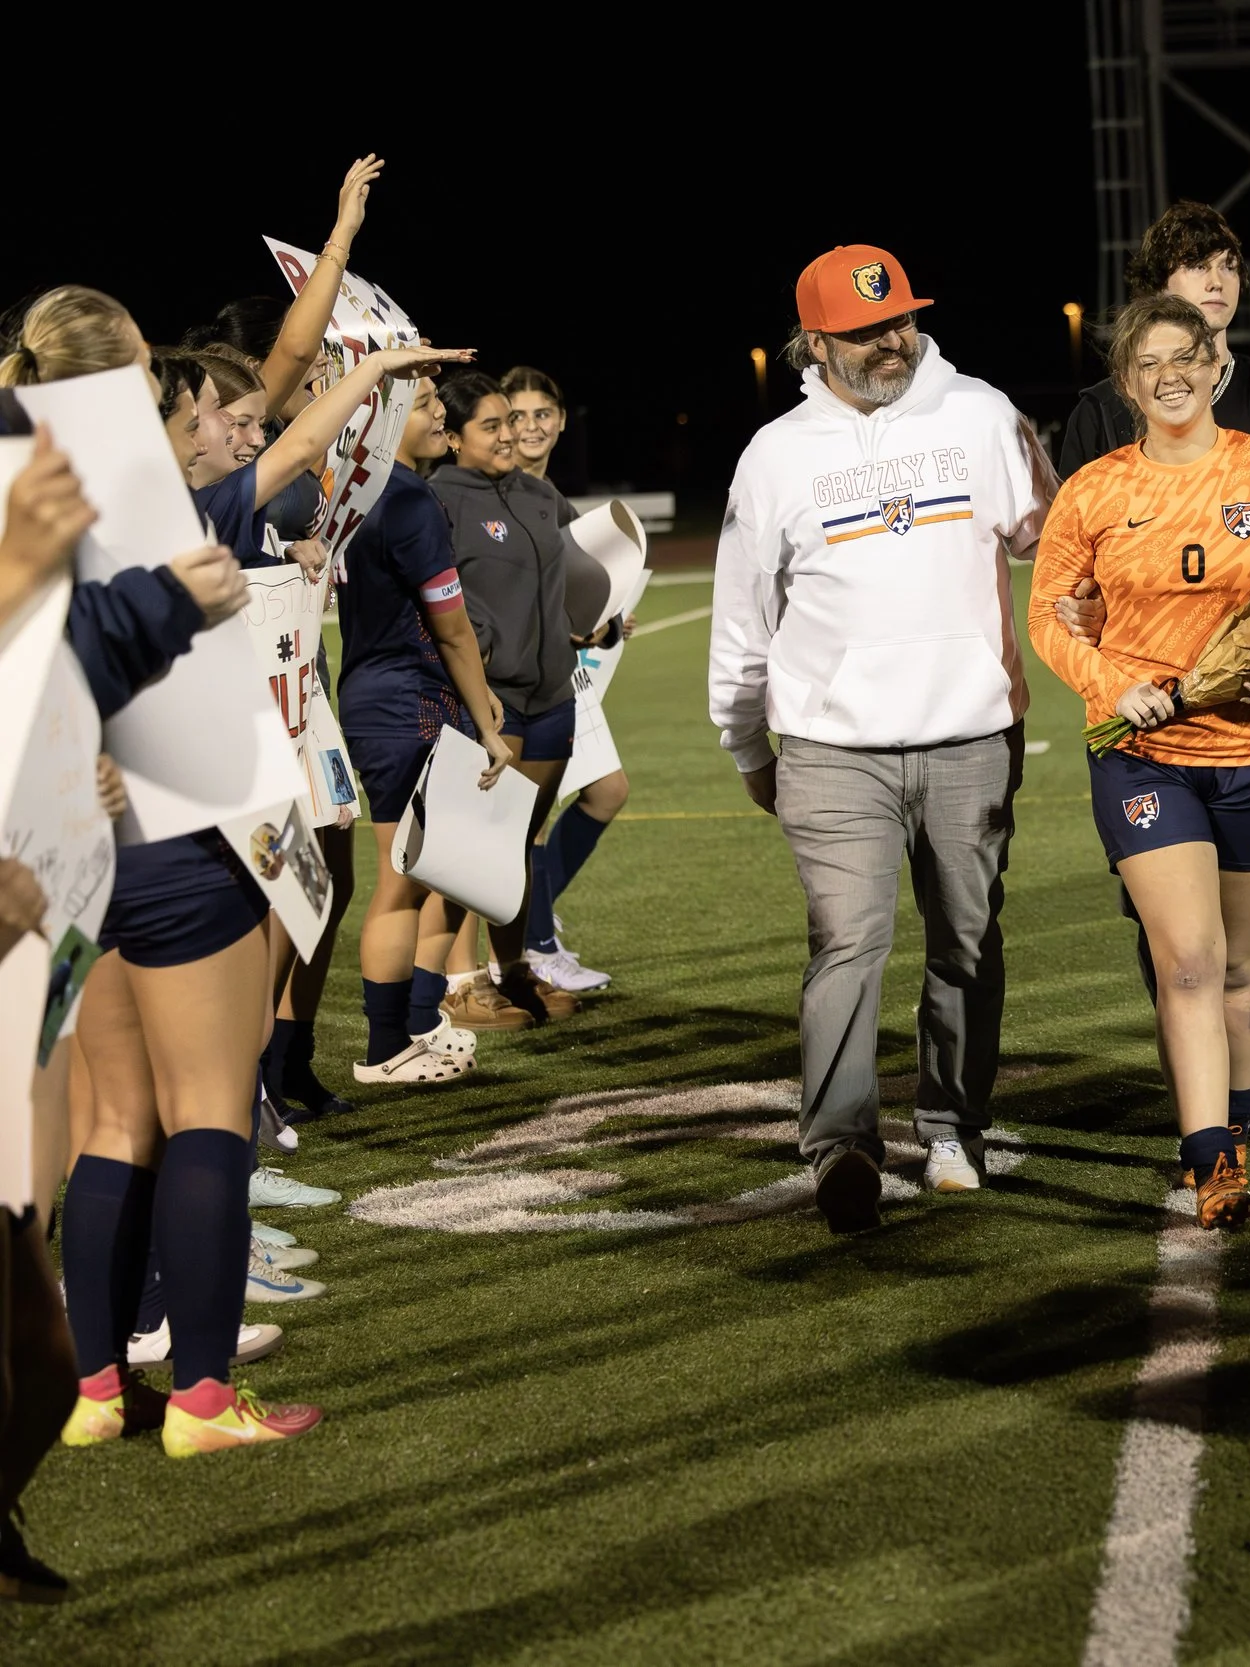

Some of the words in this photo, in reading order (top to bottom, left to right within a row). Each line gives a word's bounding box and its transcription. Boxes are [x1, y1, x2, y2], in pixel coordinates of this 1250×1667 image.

[813, 453, 925, 508] GRIZZLY
[932, 447, 968, 482] FC
[1181, 544, 1206, 584] 0
